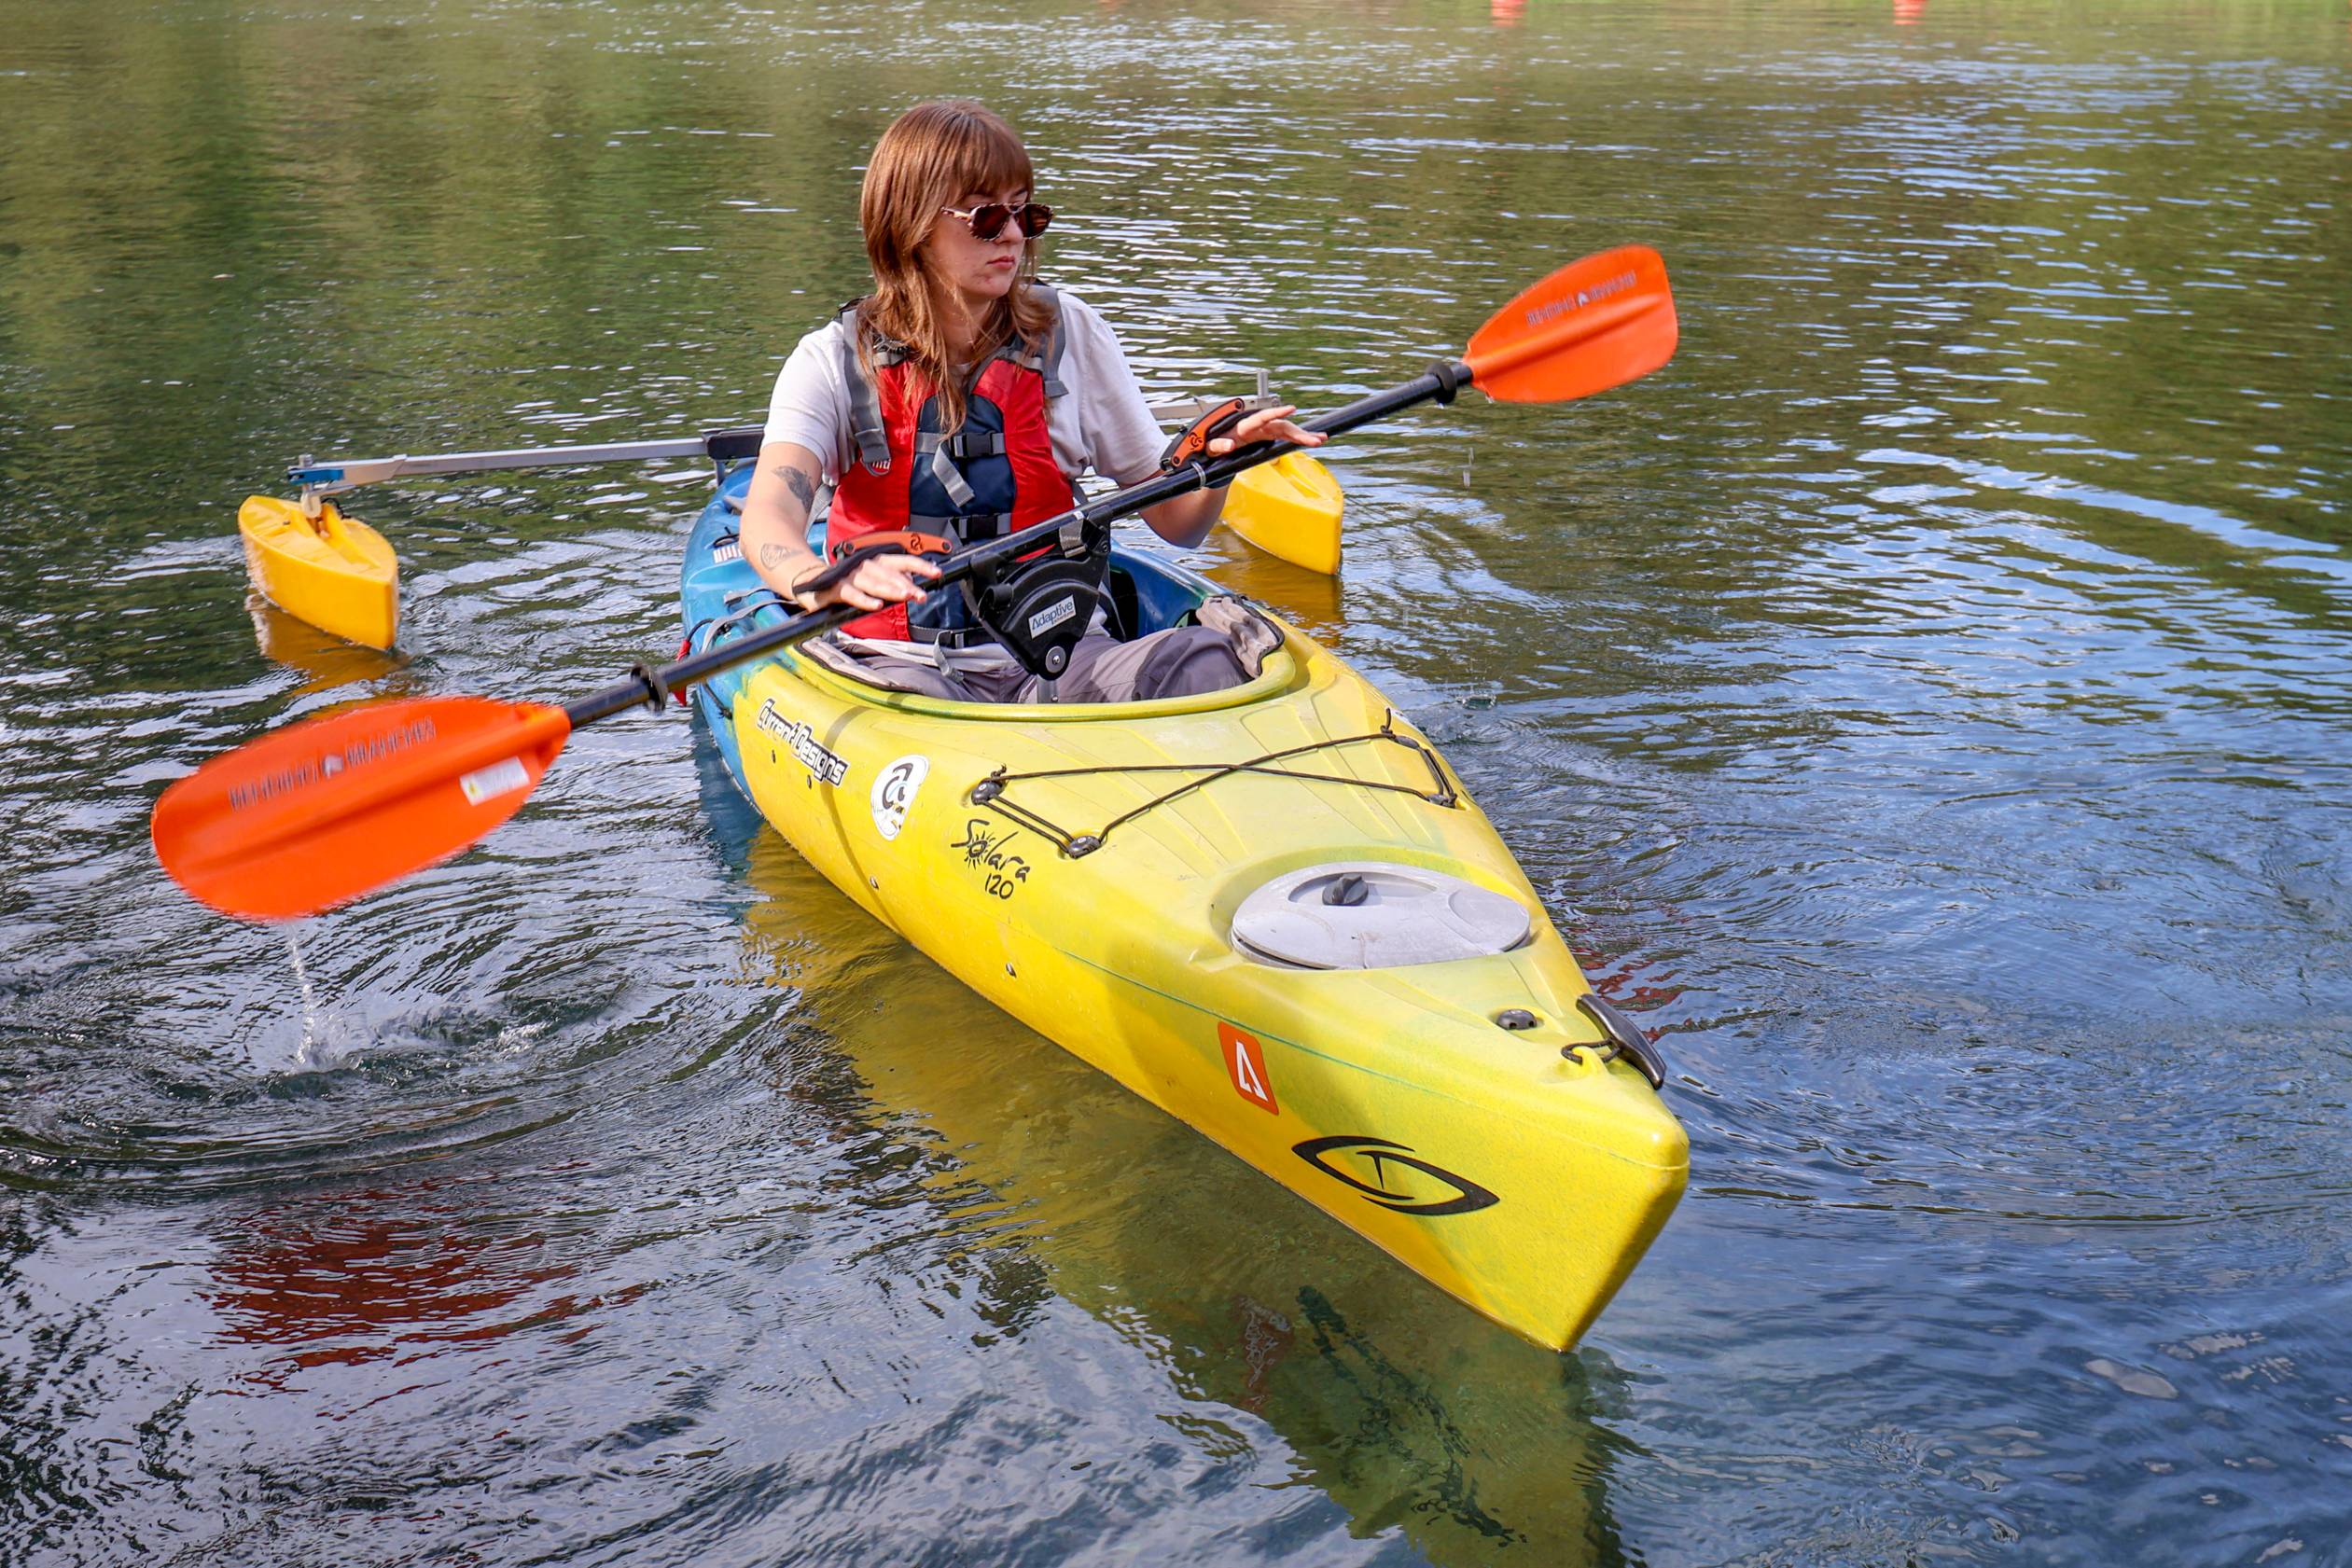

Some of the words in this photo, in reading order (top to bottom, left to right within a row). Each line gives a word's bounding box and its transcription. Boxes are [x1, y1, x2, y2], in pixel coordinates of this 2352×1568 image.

[1031, 601, 1074, 631] Adaptive
[757, 697, 801, 746] Current
[791, 725, 850, 787] Designs
[950, 818, 1031, 883] Solara
[984, 872, 1015, 900] 120
